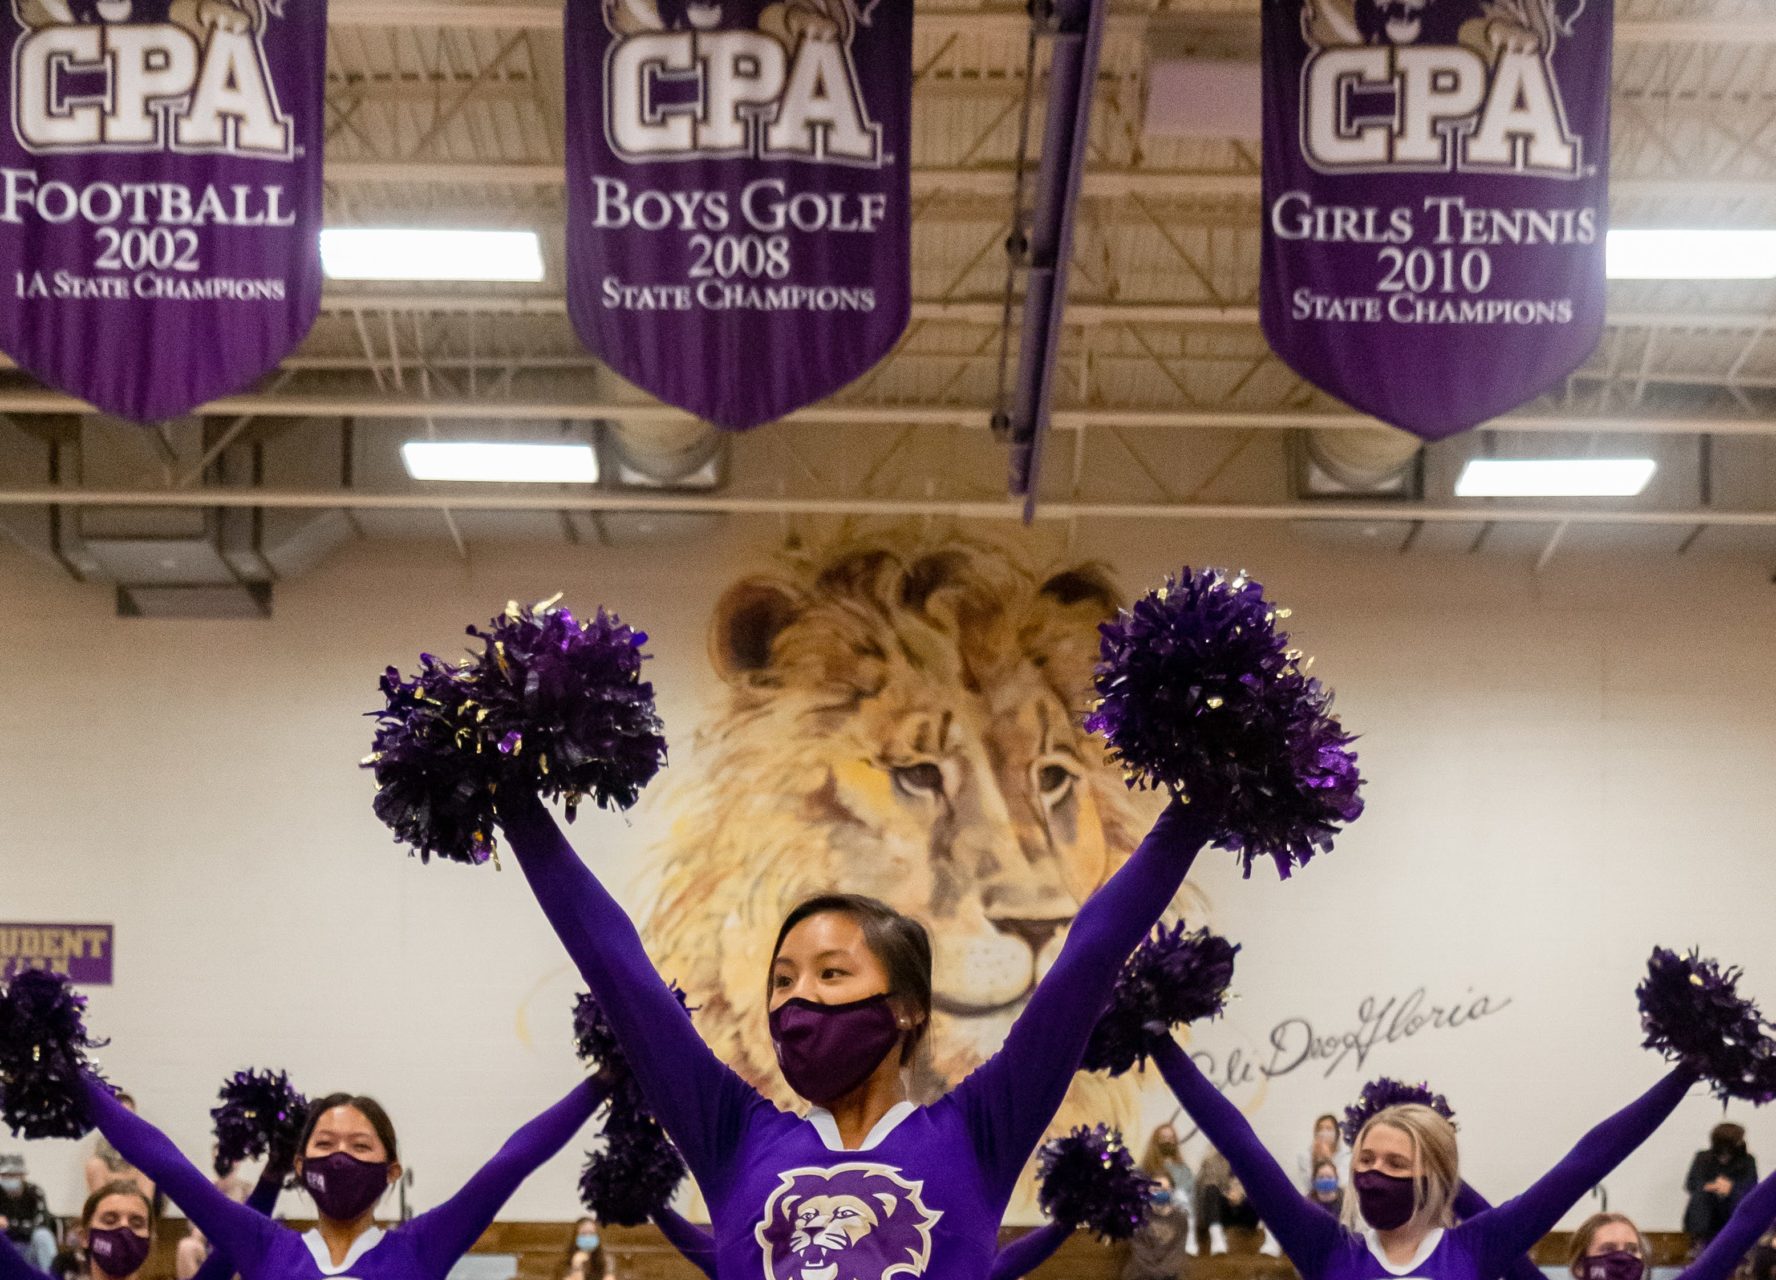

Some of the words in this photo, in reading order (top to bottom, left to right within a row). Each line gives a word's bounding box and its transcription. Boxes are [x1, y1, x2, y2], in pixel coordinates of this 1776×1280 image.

[11, 24, 294, 161] CPA
[602, 30, 883, 168] CPA
[1300, 44, 1582, 180] CPA
[0, 168, 296, 226] FOOTBALL
[591, 175, 730, 231] BOYS
[741, 178, 887, 232] GOLF
[1271, 190, 1414, 244] GIRLS
[1423, 195, 1597, 245] TENNIS
[94, 227, 200, 271] 2002
[688, 234, 791, 279] 2008
[1377, 246, 1491, 293] 2010
[16, 270, 49, 298] 1A
[53, 269, 130, 299] STATE
[133, 271, 286, 300] CHAMPIONS
[602, 276, 691, 310] STATE
[696, 279, 876, 312] CHAMPIONS
[1292, 288, 1382, 322] STATE
[1387, 294, 1573, 324] CHAMPIONS
